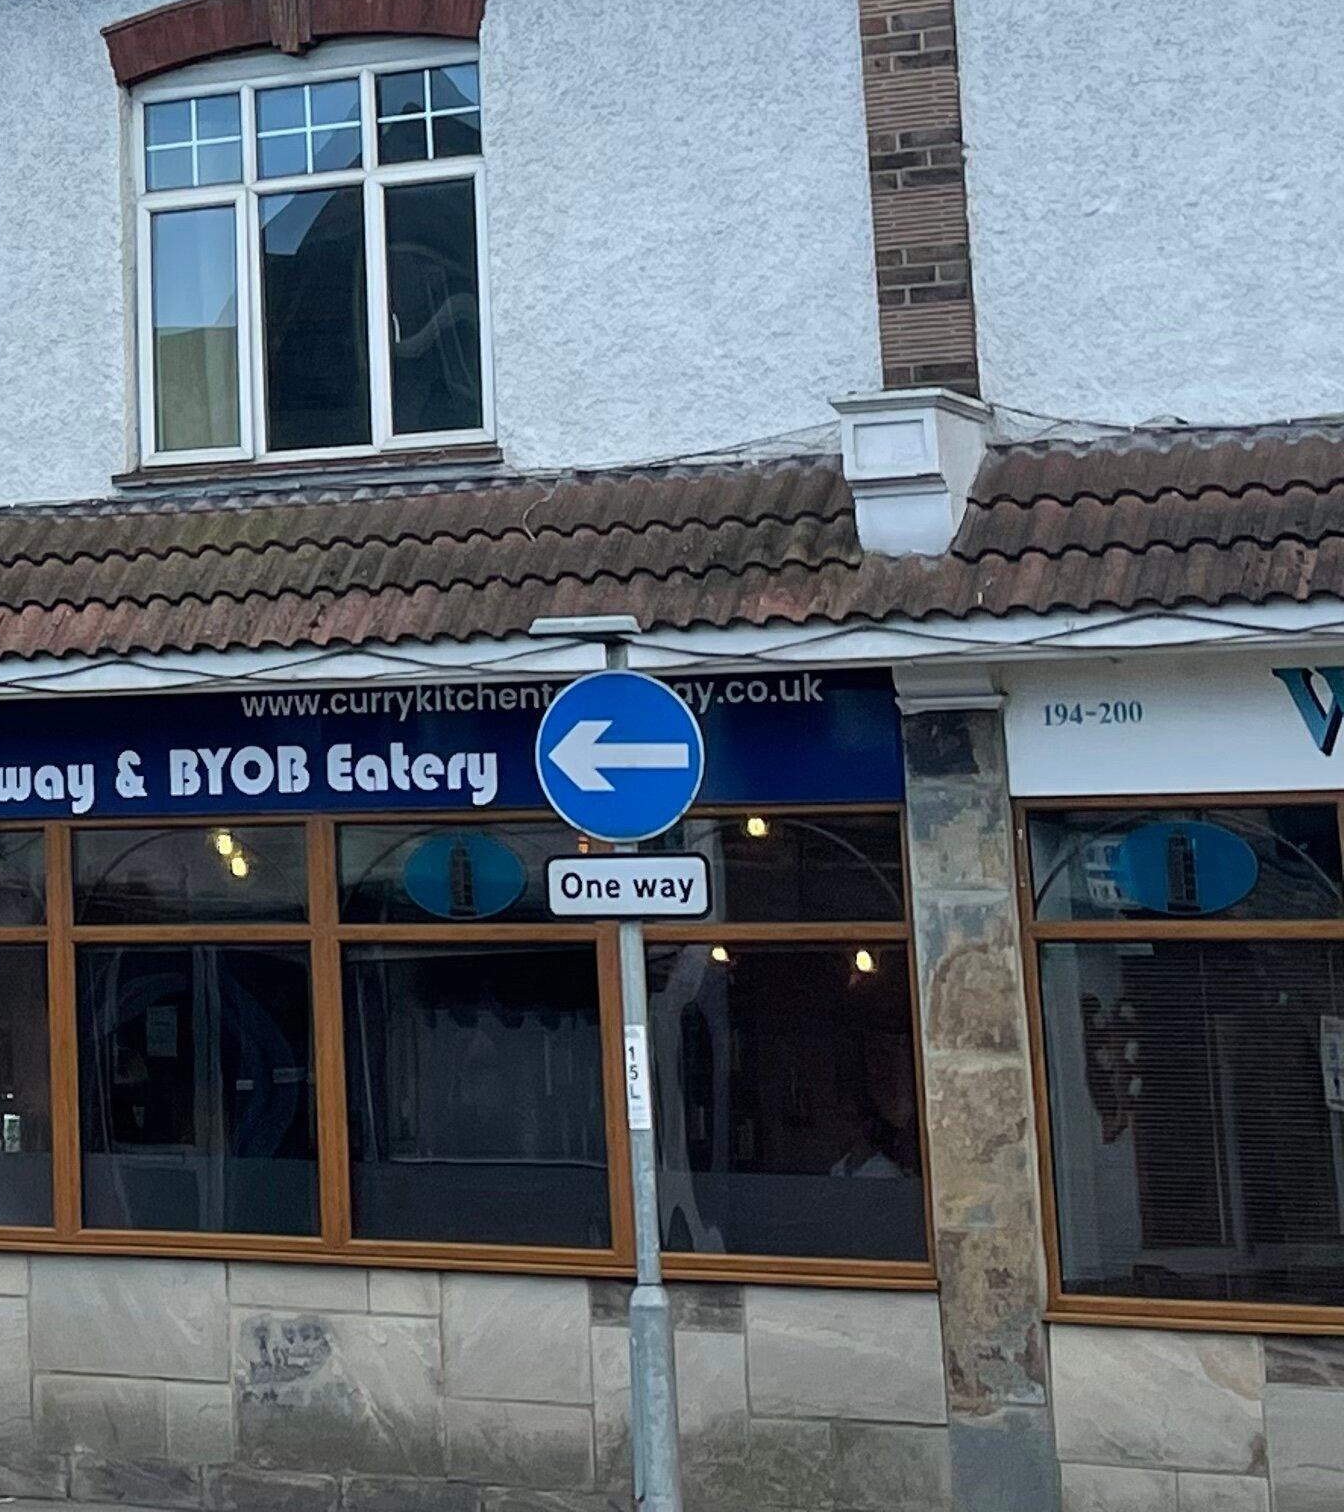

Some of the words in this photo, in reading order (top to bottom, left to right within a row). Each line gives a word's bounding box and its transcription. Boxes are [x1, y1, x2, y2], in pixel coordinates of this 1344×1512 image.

[240, 672, 824, 722] www.currykitchentay.co.uk
[1043, 701, 1143, 727] 194-200
[115, 750, 148, 798] &
[169, 745, 310, 796] BYOB
[326, 742, 498, 805] Eatery
[561, 872, 621, 899] One
[633, 878, 694, 903] way
